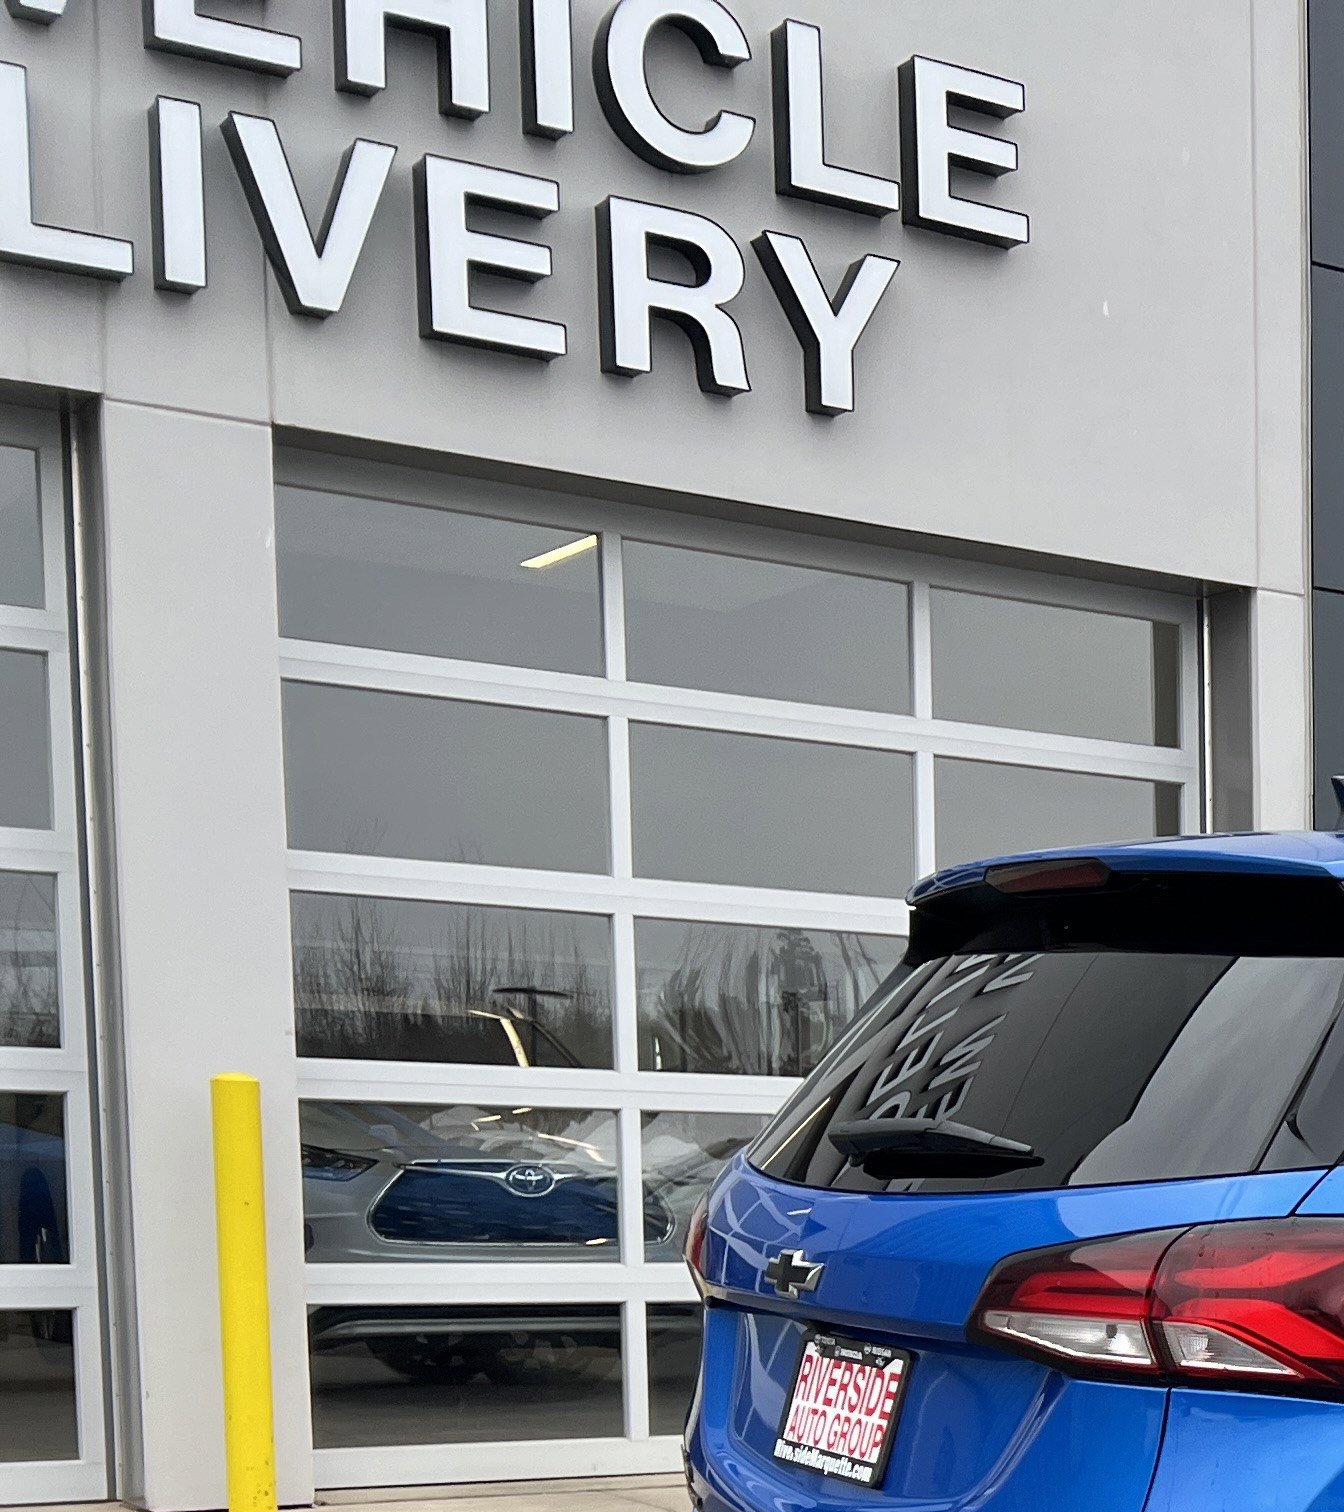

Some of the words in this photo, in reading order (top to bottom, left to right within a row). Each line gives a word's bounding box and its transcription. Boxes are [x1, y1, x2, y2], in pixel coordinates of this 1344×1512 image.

[4, 0, 1030, 250] HICLE
[795, 1354, 901, 1420] RIVERSIDE
[787, 1404, 827, 1447] AUTO
[826, 1413, 886, 1459] GROUP
